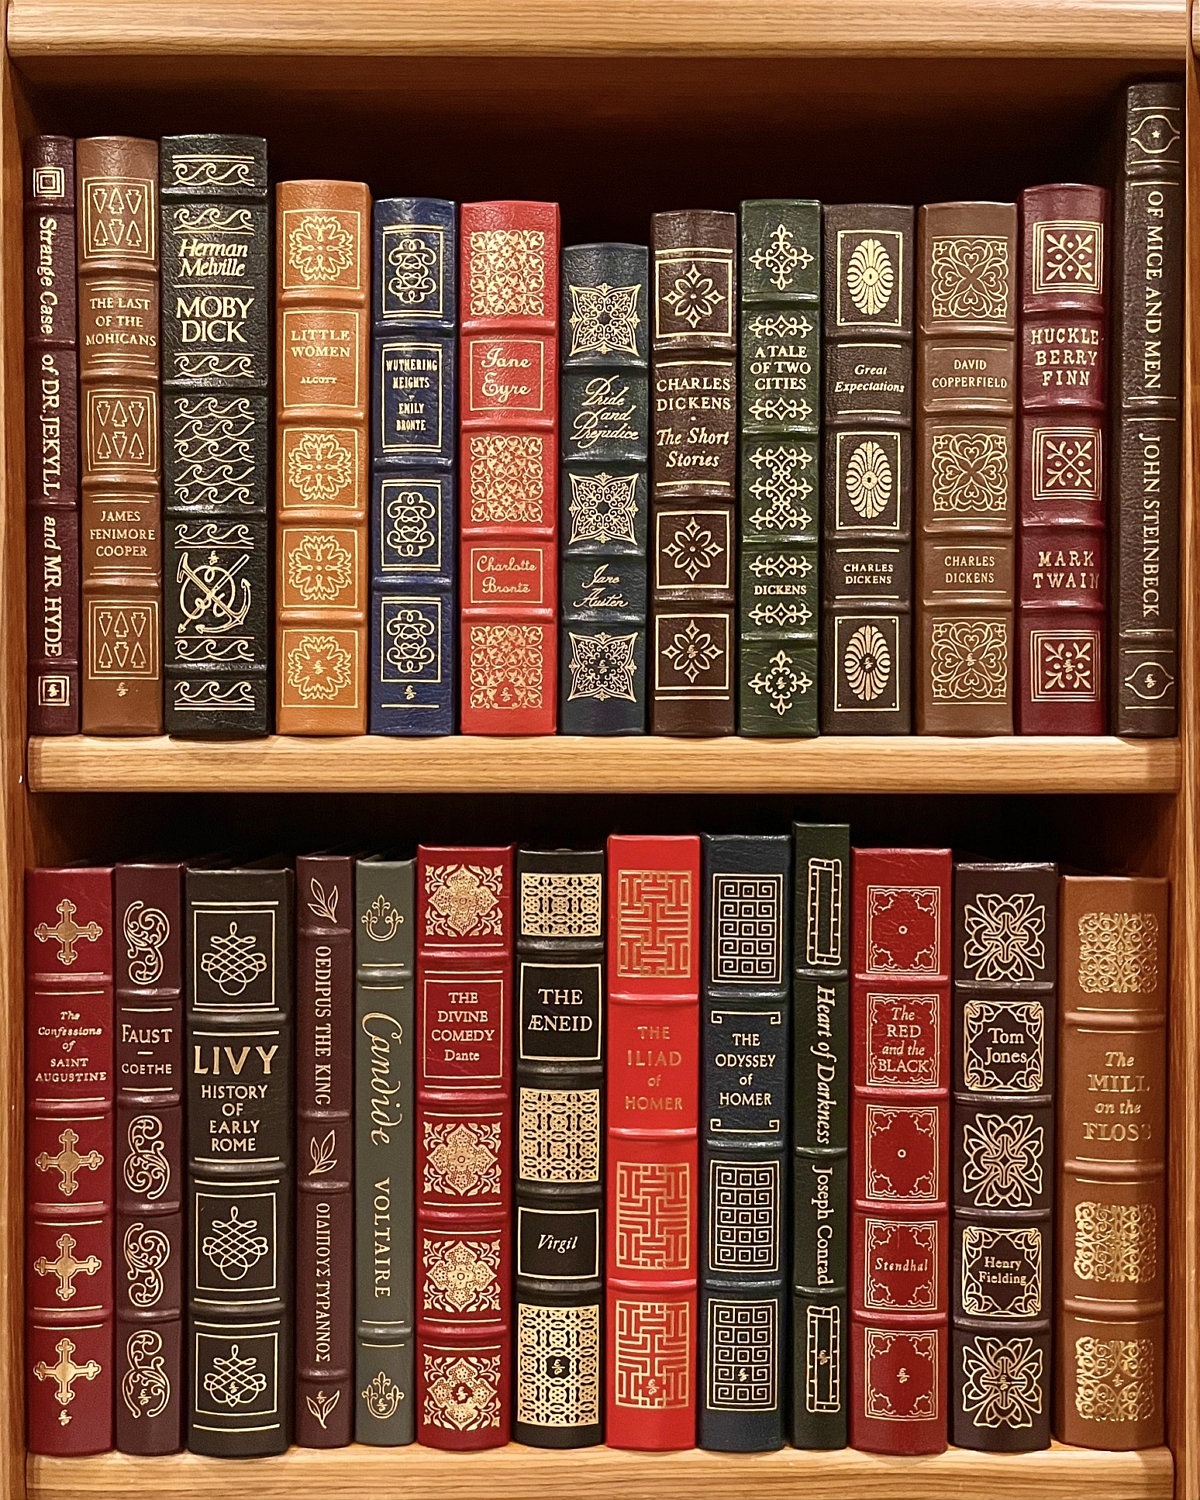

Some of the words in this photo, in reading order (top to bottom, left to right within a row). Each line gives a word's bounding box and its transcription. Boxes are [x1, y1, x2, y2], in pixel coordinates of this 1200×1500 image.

[1146, 190, 1164, 219] OF
[177, 237, 249, 258] Herman
[1145, 225, 1164, 281] MICE
[177, 256, 246, 278] Melville
[175, 294, 255, 319] MOBY
[1145, 286, 1163, 334] AND
[180, 319, 248, 343] DICK
[290, 329, 351, 342] LITTLE
[290, 344, 351, 358] WOMEN
[953, 359, 987, 371] DAVID
[1144, 340, 1162, 389] MEN
[656, 377, 731, 393] CHARLES
[754, 377, 807, 391] CITIES
[931, 376, 1008, 389] COPPERFIELD
[1042, 369, 1091, 387] FINN
[834, 380, 905, 395] Expectations
[656, 396, 732, 412] DICKENS
[1138, 432, 1161, 493] JOHN
[89, 528, 156, 541] FENIMORE
[95, 545, 148, 557] COOPER
[1142, 499, 1161, 618] STEINBECK
[314, 946, 332, 1018] OEDIPUS
[527, 1014, 593, 1032] ÆNEID
[886, 1023, 922, 1038] RED
[121, 1023, 173, 1044] FAUST
[315, 1022, 332, 1057] THE
[431, 1029, 496, 1042] COMEDY
[987, 1027, 1025, 1044] Tom
[193, 1044, 279, 1075] LIVY
[444, 1049, 480, 1062] Dante
[627, 1049, 683, 1067] ILIAD
[715, 1053, 776, 1068] ODYSSEY
[121, 1063, 172, 1075] GOETHE
[314, 1063, 332, 1105] KING
[361, 1012, 403, 1146] Candide
[201, 1084, 268, 1100] HISTORY
[719, 1092, 772, 1106] HOMER
[211, 1137, 257, 1152] ROME
[811, 1164, 835, 1221] Joseph
[373, 1176, 391, 1298] VOLTAIRE
[537, 1234, 578, 1254] Virgil
[817, 1224, 835, 1286] Conrad
[984, 1256, 1022, 1275] Henry
